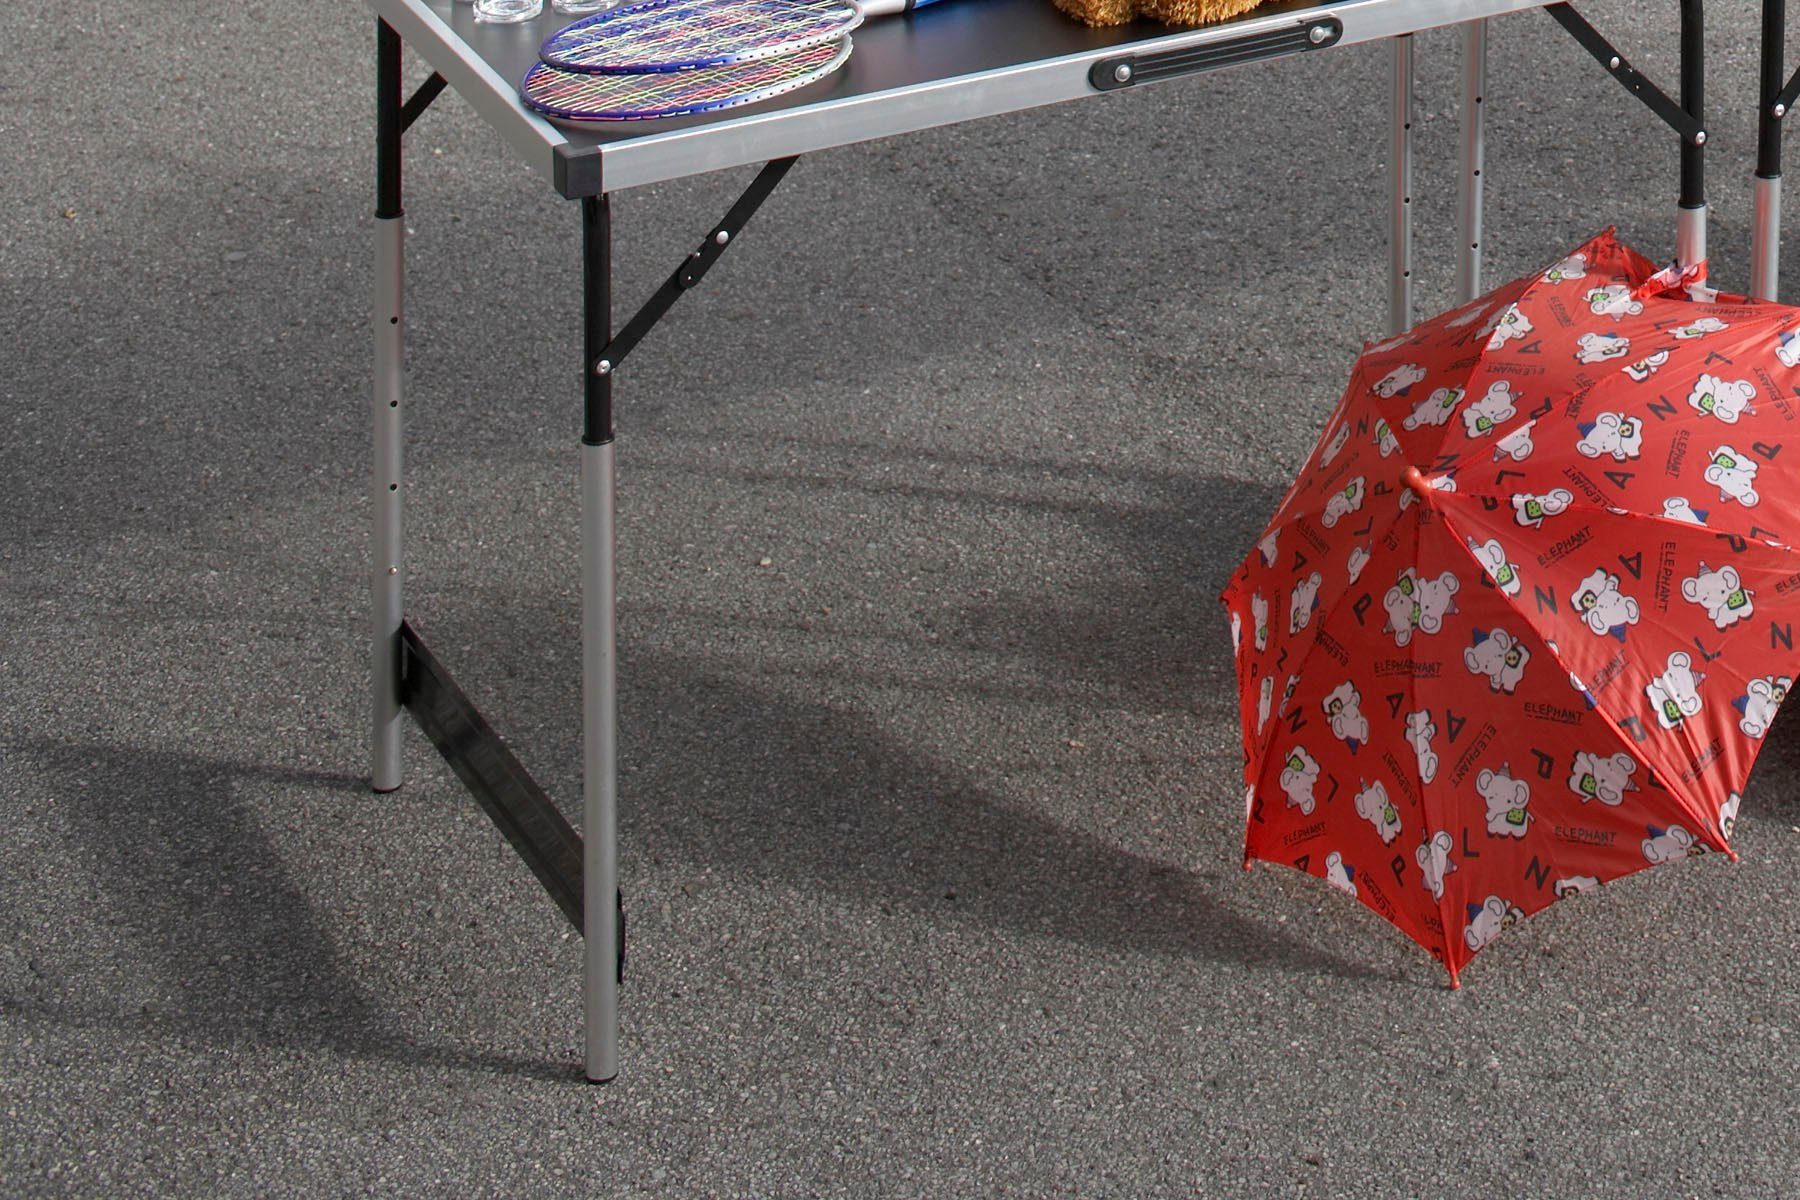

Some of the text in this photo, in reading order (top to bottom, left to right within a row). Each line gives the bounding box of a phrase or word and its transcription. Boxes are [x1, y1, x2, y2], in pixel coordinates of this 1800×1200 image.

[1516, 340, 1543, 354] A
[1484, 364, 1546, 377] ELEPHANT
[1646, 395, 1678, 421] N
[1754, 367, 1797, 422] ELEPHANT
[1356, 414, 1370, 438] N
[1432, 453, 1461, 472] N
[1673, 429, 1691, 480] ELEPHANT
[1752, 440, 1783, 461] P
[1374, 480, 1394, 497] P
[1495, 469, 1526, 485] L
[1603, 470, 1636, 490] A
[1536, 526, 1593, 566] ELEPHANT
[1716, 532, 1749, 553] P
[1292, 551, 1308, 573] A
[1617, 551, 1643, 581] A
[1656, 541, 1677, 613] ELEPHANT
[1352, 592, 1373, 626] P
[1533, 584, 1559, 615] N
[1693, 635, 1723, 664] L
[1769, 621, 1794, 651] N
[1285, 705, 1308, 735] N
[1386, 692, 1404, 720] A
[1523, 702, 1585, 723] ELEPHANT
[1446, 707, 1468, 744] A
[1617, 714, 1648, 743] P
[1452, 724, 1498, 789] ELEPHANT
[1529, 747, 1555, 781] P
[1382, 752, 1419, 808] ELEPHANT
[1283, 820, 1328, 847] ELEPHANT
[1462, 826, 1480, 859] L
[1554, 825, 1618, 844] ELEPHANT
[1390, 853, 1407, 888] P
[1523, 854, 1552, 892] N
